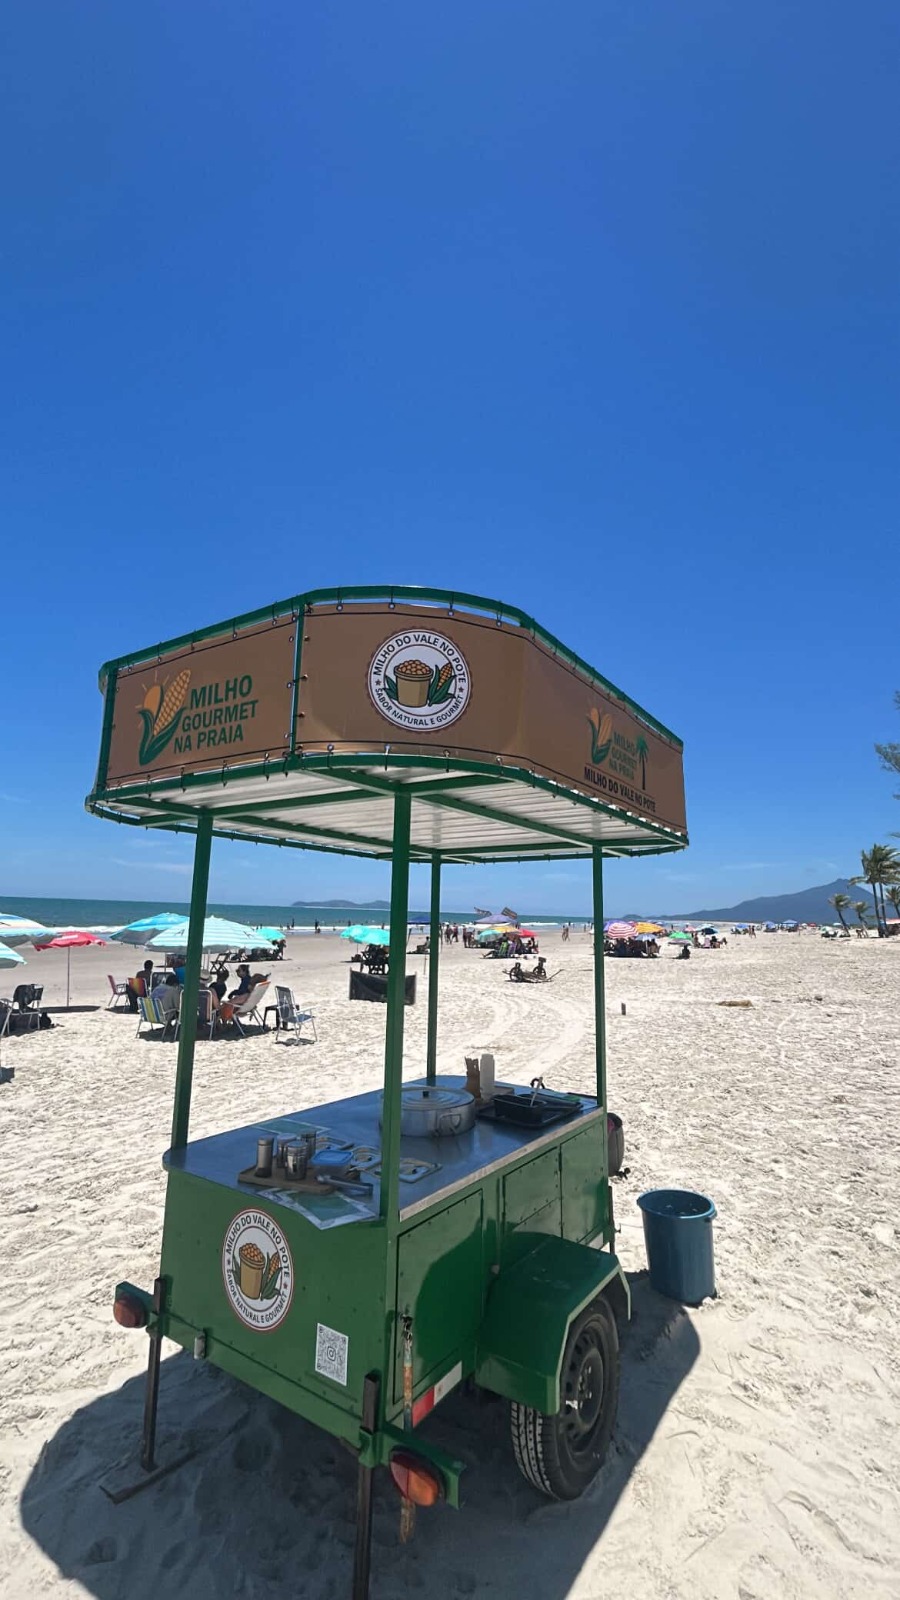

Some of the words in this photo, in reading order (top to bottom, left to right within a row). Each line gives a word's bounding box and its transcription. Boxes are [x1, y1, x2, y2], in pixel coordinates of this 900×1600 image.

[373, 644, 396, 676] MILHO
[395, 635, 412, 648] DO
[413, 634, 440, 647] VALE
[439, 641, 455, 657] NO
[452, 657, 467, 683] POTE
[190, 674, 253, 710] MILHO
[375, 688, 392, 713] SABOR
[391, 709, 429, 726] NATURAL
[430, 717, 436, 725] E
[436, 695, 464, 723] GOURMET
[182, 699, 259, 733] GOURMET
[173, 734, 192, 754] NA
[197, 723, 244, 749] PRAIA
[584, 766, 607, 789] MILHO
[608, 777, 619, 794] DO
[620, 785, 635, 802] VALE
[226, 1223, 241, 1255] MILHO
[241, 1215, 252, 1227] DO
[252, 1214, 271, 1231] VALE
[270, 1227, 282, 1245] NO
[279, 1247, 290, 1278] POTE
[236, 1296, 261, 1323] NATURAL
